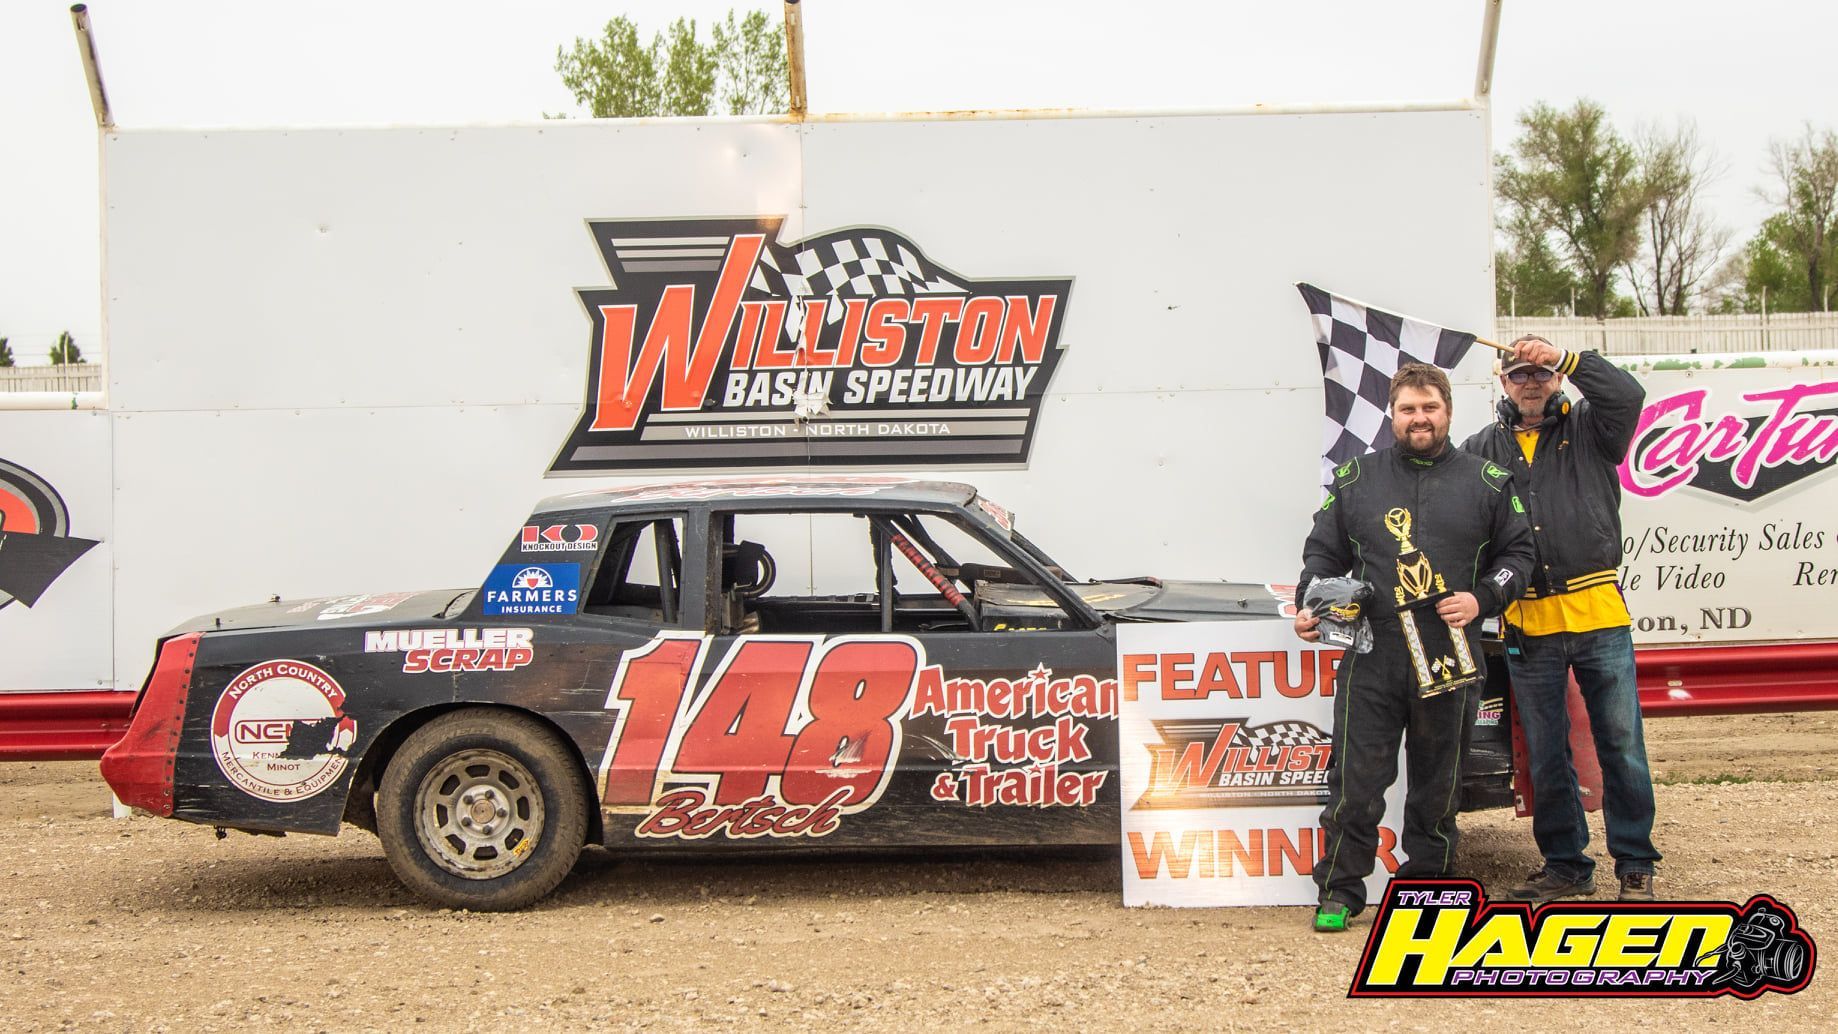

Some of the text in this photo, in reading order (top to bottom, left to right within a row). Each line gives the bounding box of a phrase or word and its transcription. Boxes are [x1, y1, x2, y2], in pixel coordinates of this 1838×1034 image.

[589, 234, 1057, 432] WILLISTON
[722, 366, 1038, 407] BASIN SPEEDWAY
[685, 424, 786, 438] WILLISTON
[806, 424, 869, 436] NORTH
[878, 423, 950, 435] DAKOTA
[521, 542, 597, 551] KNOCKOUT DESIGN
[1759, 522, 1825, 551] Sales
[1656, 564, 1726, 591] Video
[487, 589, 577, 602] FARMERS
[501, 605, 562, 613] INSURANCE
[1700, 607, 1752, 630] ND
[364, 628, 534, 652] MUELLER
[402, 648, 533, 673] SCRAP
[228, 664, 338, 700] NORTH COUNTRY
[909, 663, 1119, 721] American
[601, 630, 926, 813] 148
[945, 714, 1094, 763] Truck
[221, 751, 280, 796] MERCANTILE
[284, 788, 293, 796] &
[267, 763, 301, 771] MINOT
[1219, 771, 1273, 786] BASIN
[930, 763, 1108, 808] & Trailer
[634, 786, 853, 839] Bertsch
